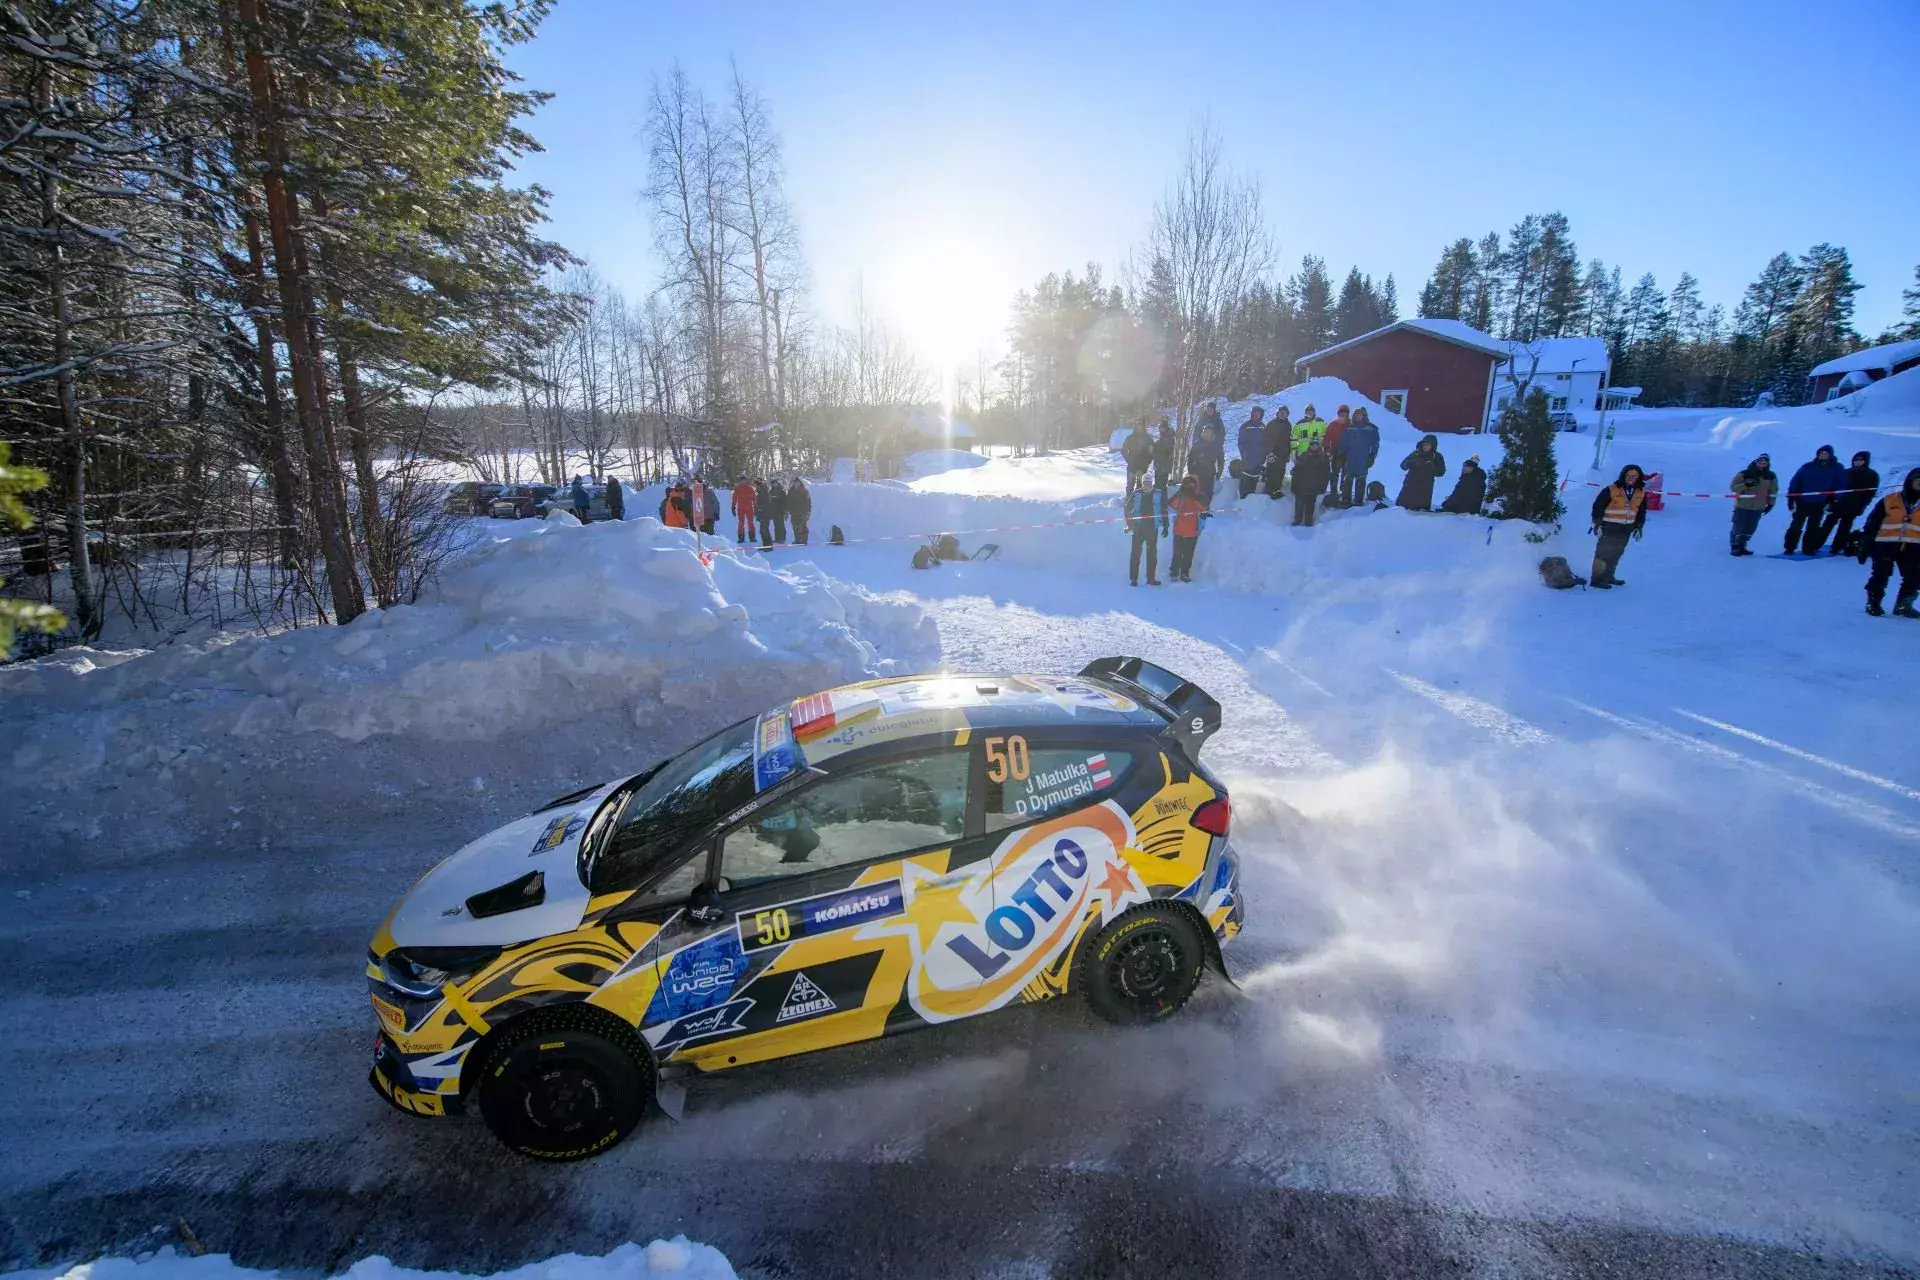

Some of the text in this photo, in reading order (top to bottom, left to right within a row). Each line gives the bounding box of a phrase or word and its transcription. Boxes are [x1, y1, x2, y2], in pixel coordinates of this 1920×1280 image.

[985, 735, 1030, 783] 50
[1025, 762, 1088, 794] J Matulka
[1015, 778, 1094, 815] D Dymurski
[815, 895, 890, 923] KOMATSU
[945, 838, 1088, 979] LOTTO
[755, 908, 791, 945] 50
[675, 965, 730, 980] JUNIOR
[694, 961, 710, 969] FIA
[673, 973, 735, 993] WRC
[683, 1007, 728, 1031] wolf
[519, 1130, 619, 1158] SOTTOZERO
